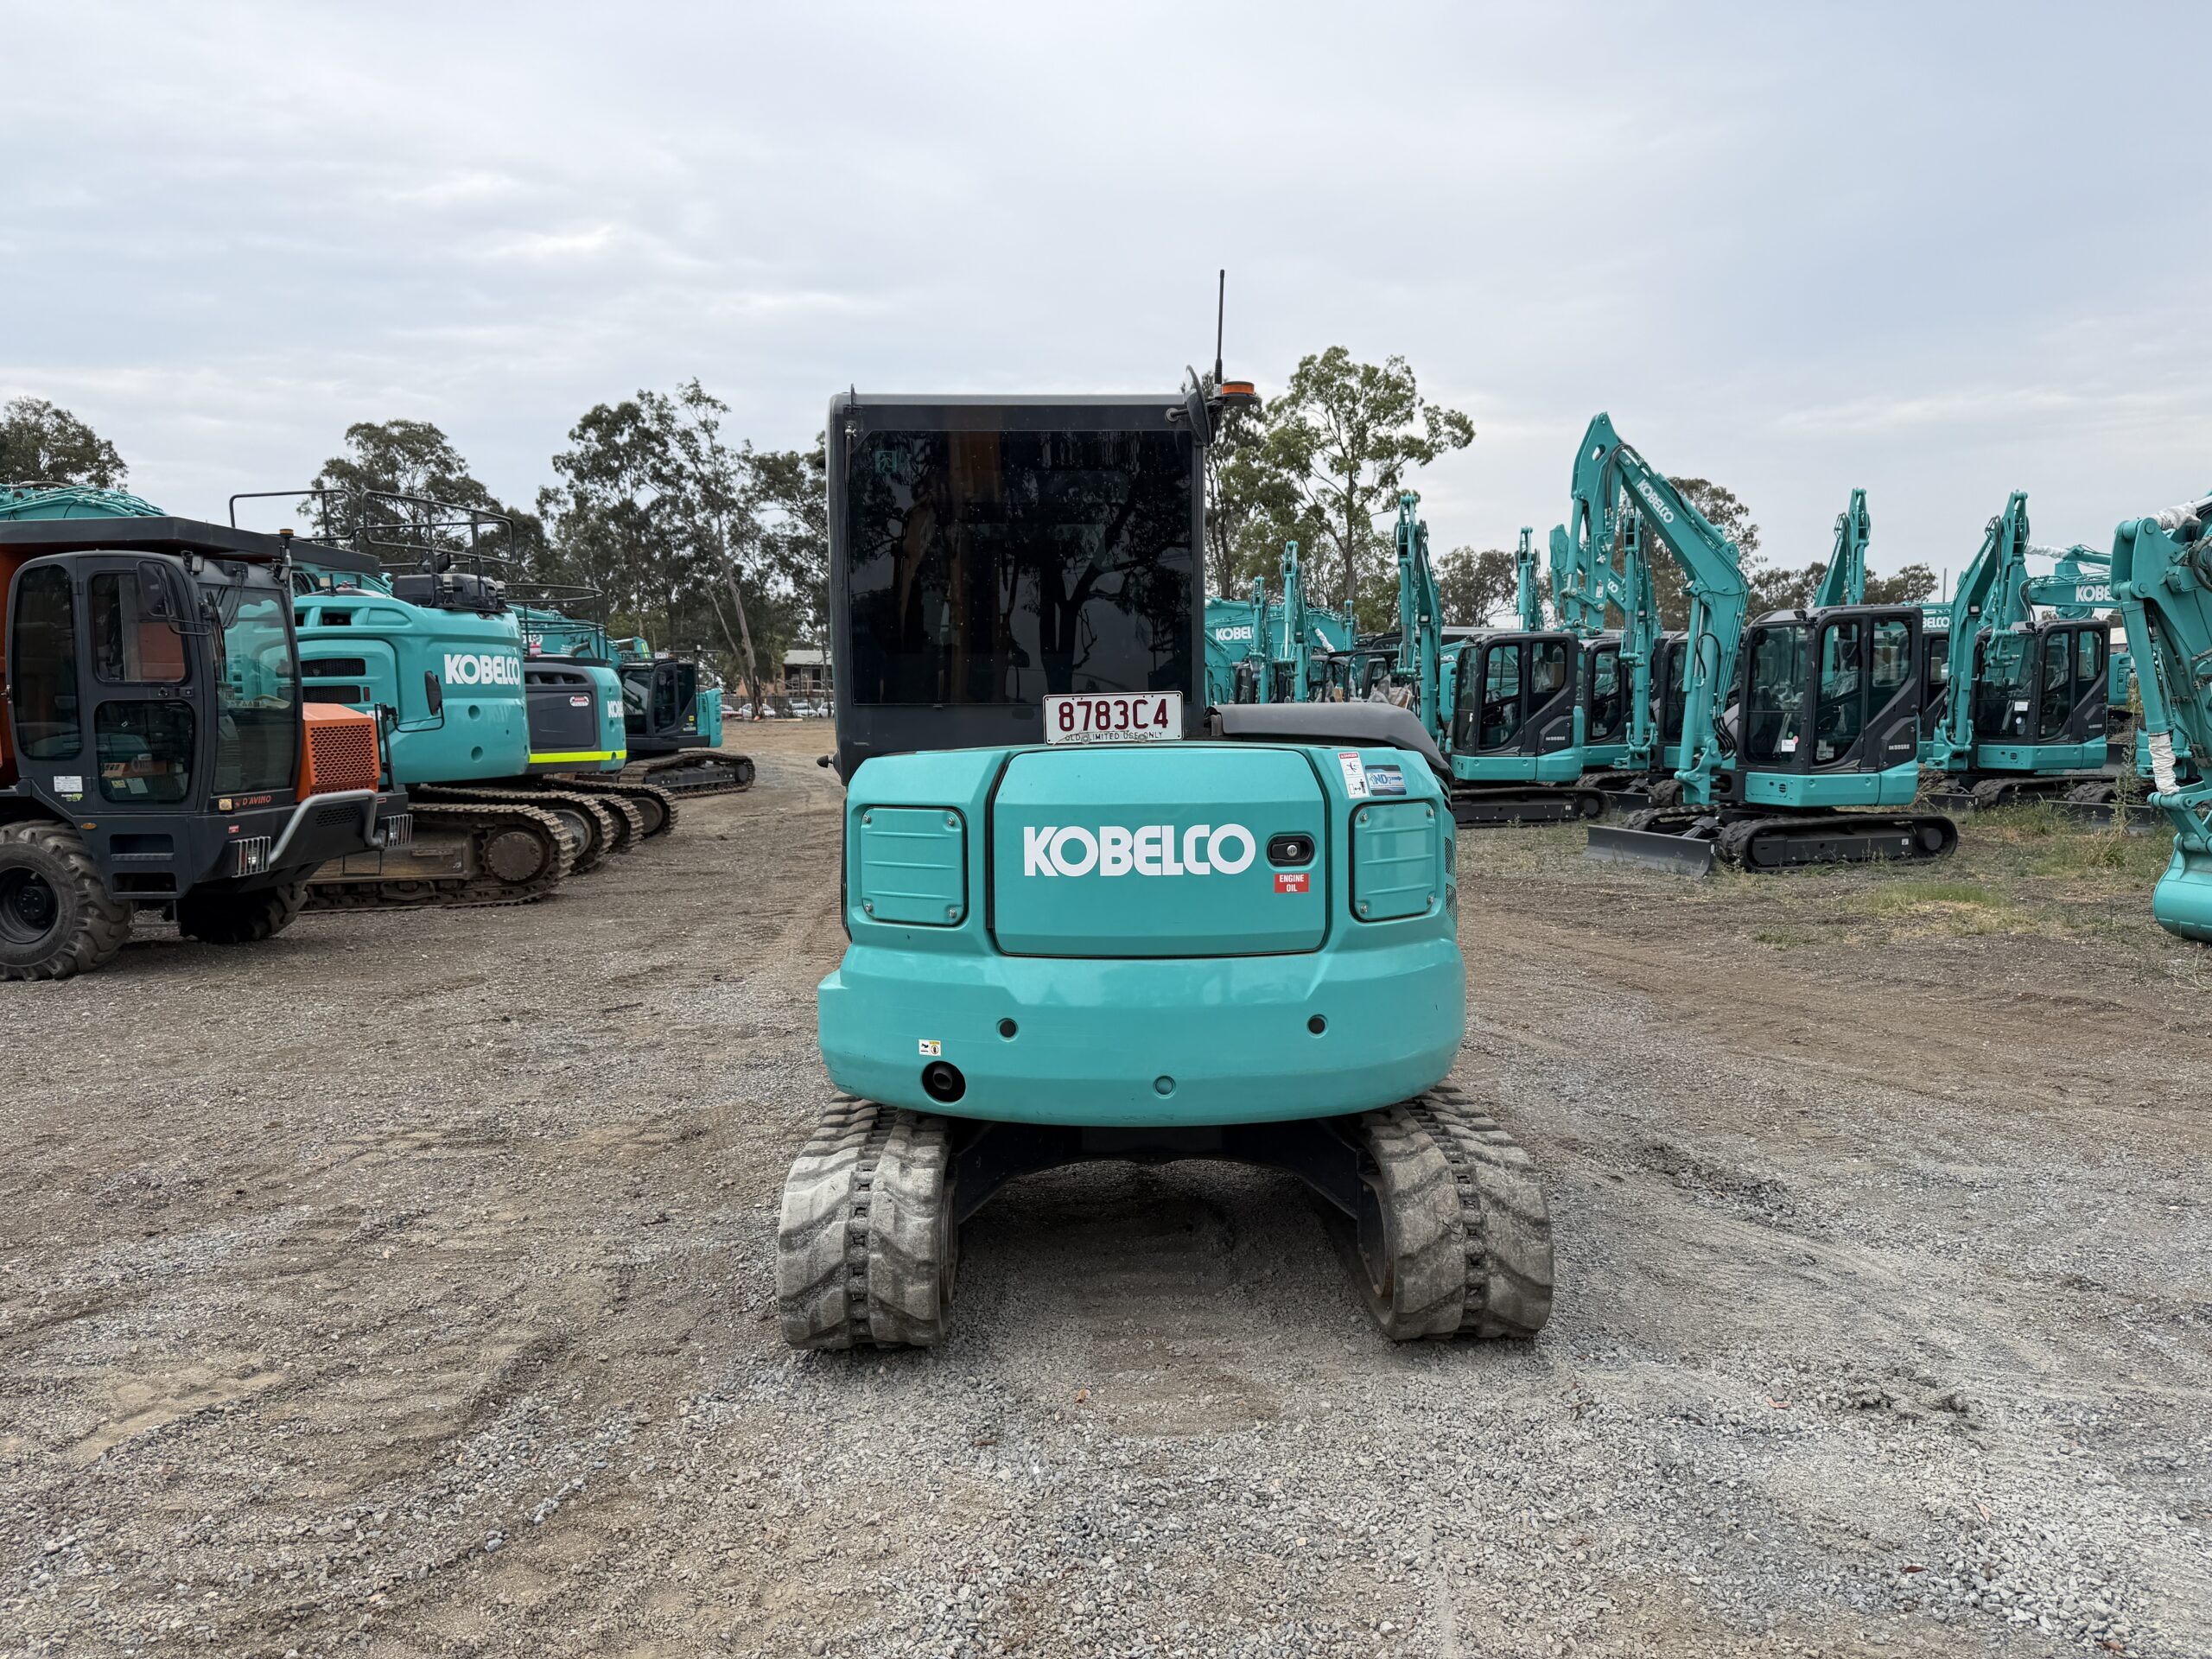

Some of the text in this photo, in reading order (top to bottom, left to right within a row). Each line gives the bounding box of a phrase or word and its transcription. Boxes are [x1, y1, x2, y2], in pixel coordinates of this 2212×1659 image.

[1637, 479, 1675, 524] KOBELCO
[2075, 584, 2116, 602] KOBE
[1923, 616, 1950, 628] BELCO
[1215, 626, 1254, 641] KOBEL
[444, 654, 520, 684] KOBELCO
[1058, 698, 1169, 732] 8783C4
[1065, 733, 1081, 741] QLD
[1123, 731, 1139, 740] USE
[1023, 823, 1256, 877] KOBELCO
[1279, 874, 1305, 883] ENGINE
[1286, 883, 1298, 893] OIL
